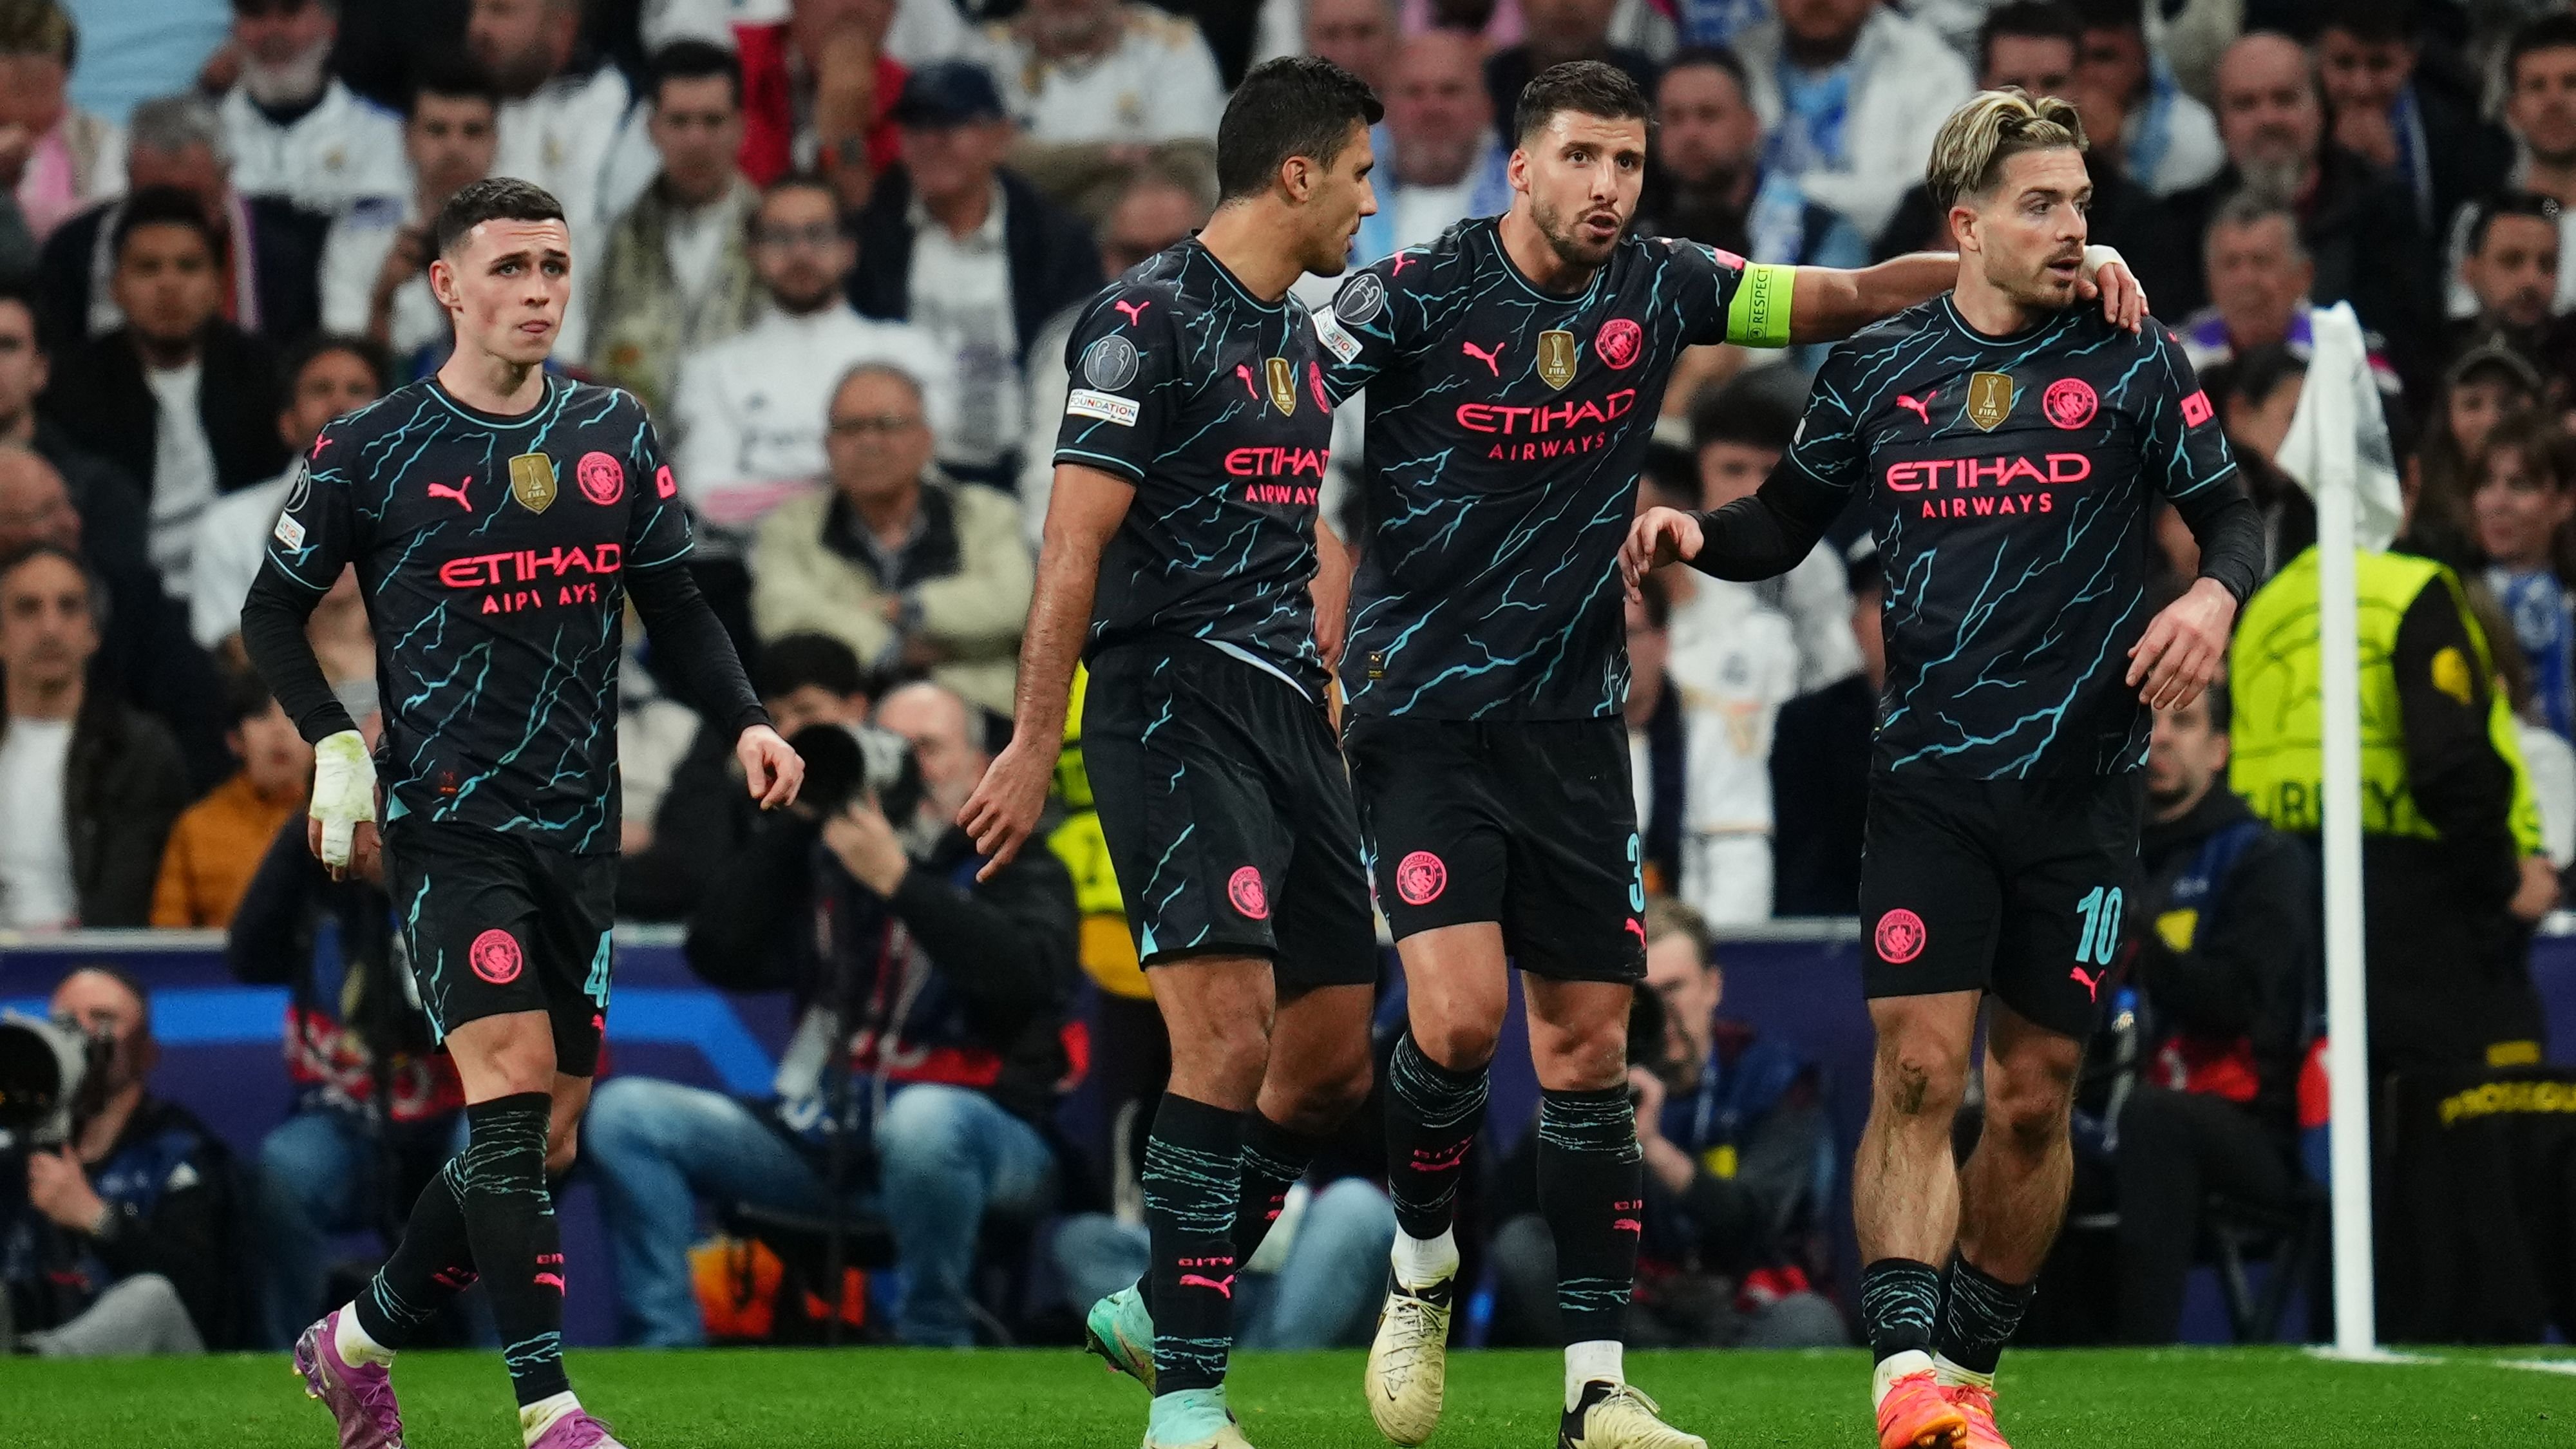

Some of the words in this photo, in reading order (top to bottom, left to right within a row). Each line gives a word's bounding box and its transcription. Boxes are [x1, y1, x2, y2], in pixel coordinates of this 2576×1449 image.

[1752, 268, 1769, 324] RESPECT
[1548, 367, 1567, 375] FIFA
[1069, 397, 1136, 417] FOUNDATION
[1455, 388, 1636, 435] ETIHAD
[1978, 407, 1998, 417] FIFA
[1488, 431, 1605, 461] AIRWAYS
[1886, 452, 2092, 492] ETIHAD
[527, 489, 547, 498] FIFA
[1922, 492, 2052, 518] AIRWAYS
[439, 543, 622, 588] ETIHAD
[482, 582, 598, 614] AIRAYS
[2075, 886, 2123, 965] 10
[583, 930, 612, 1009] 4
[1178, 1256, 1234, 1267] CITY
